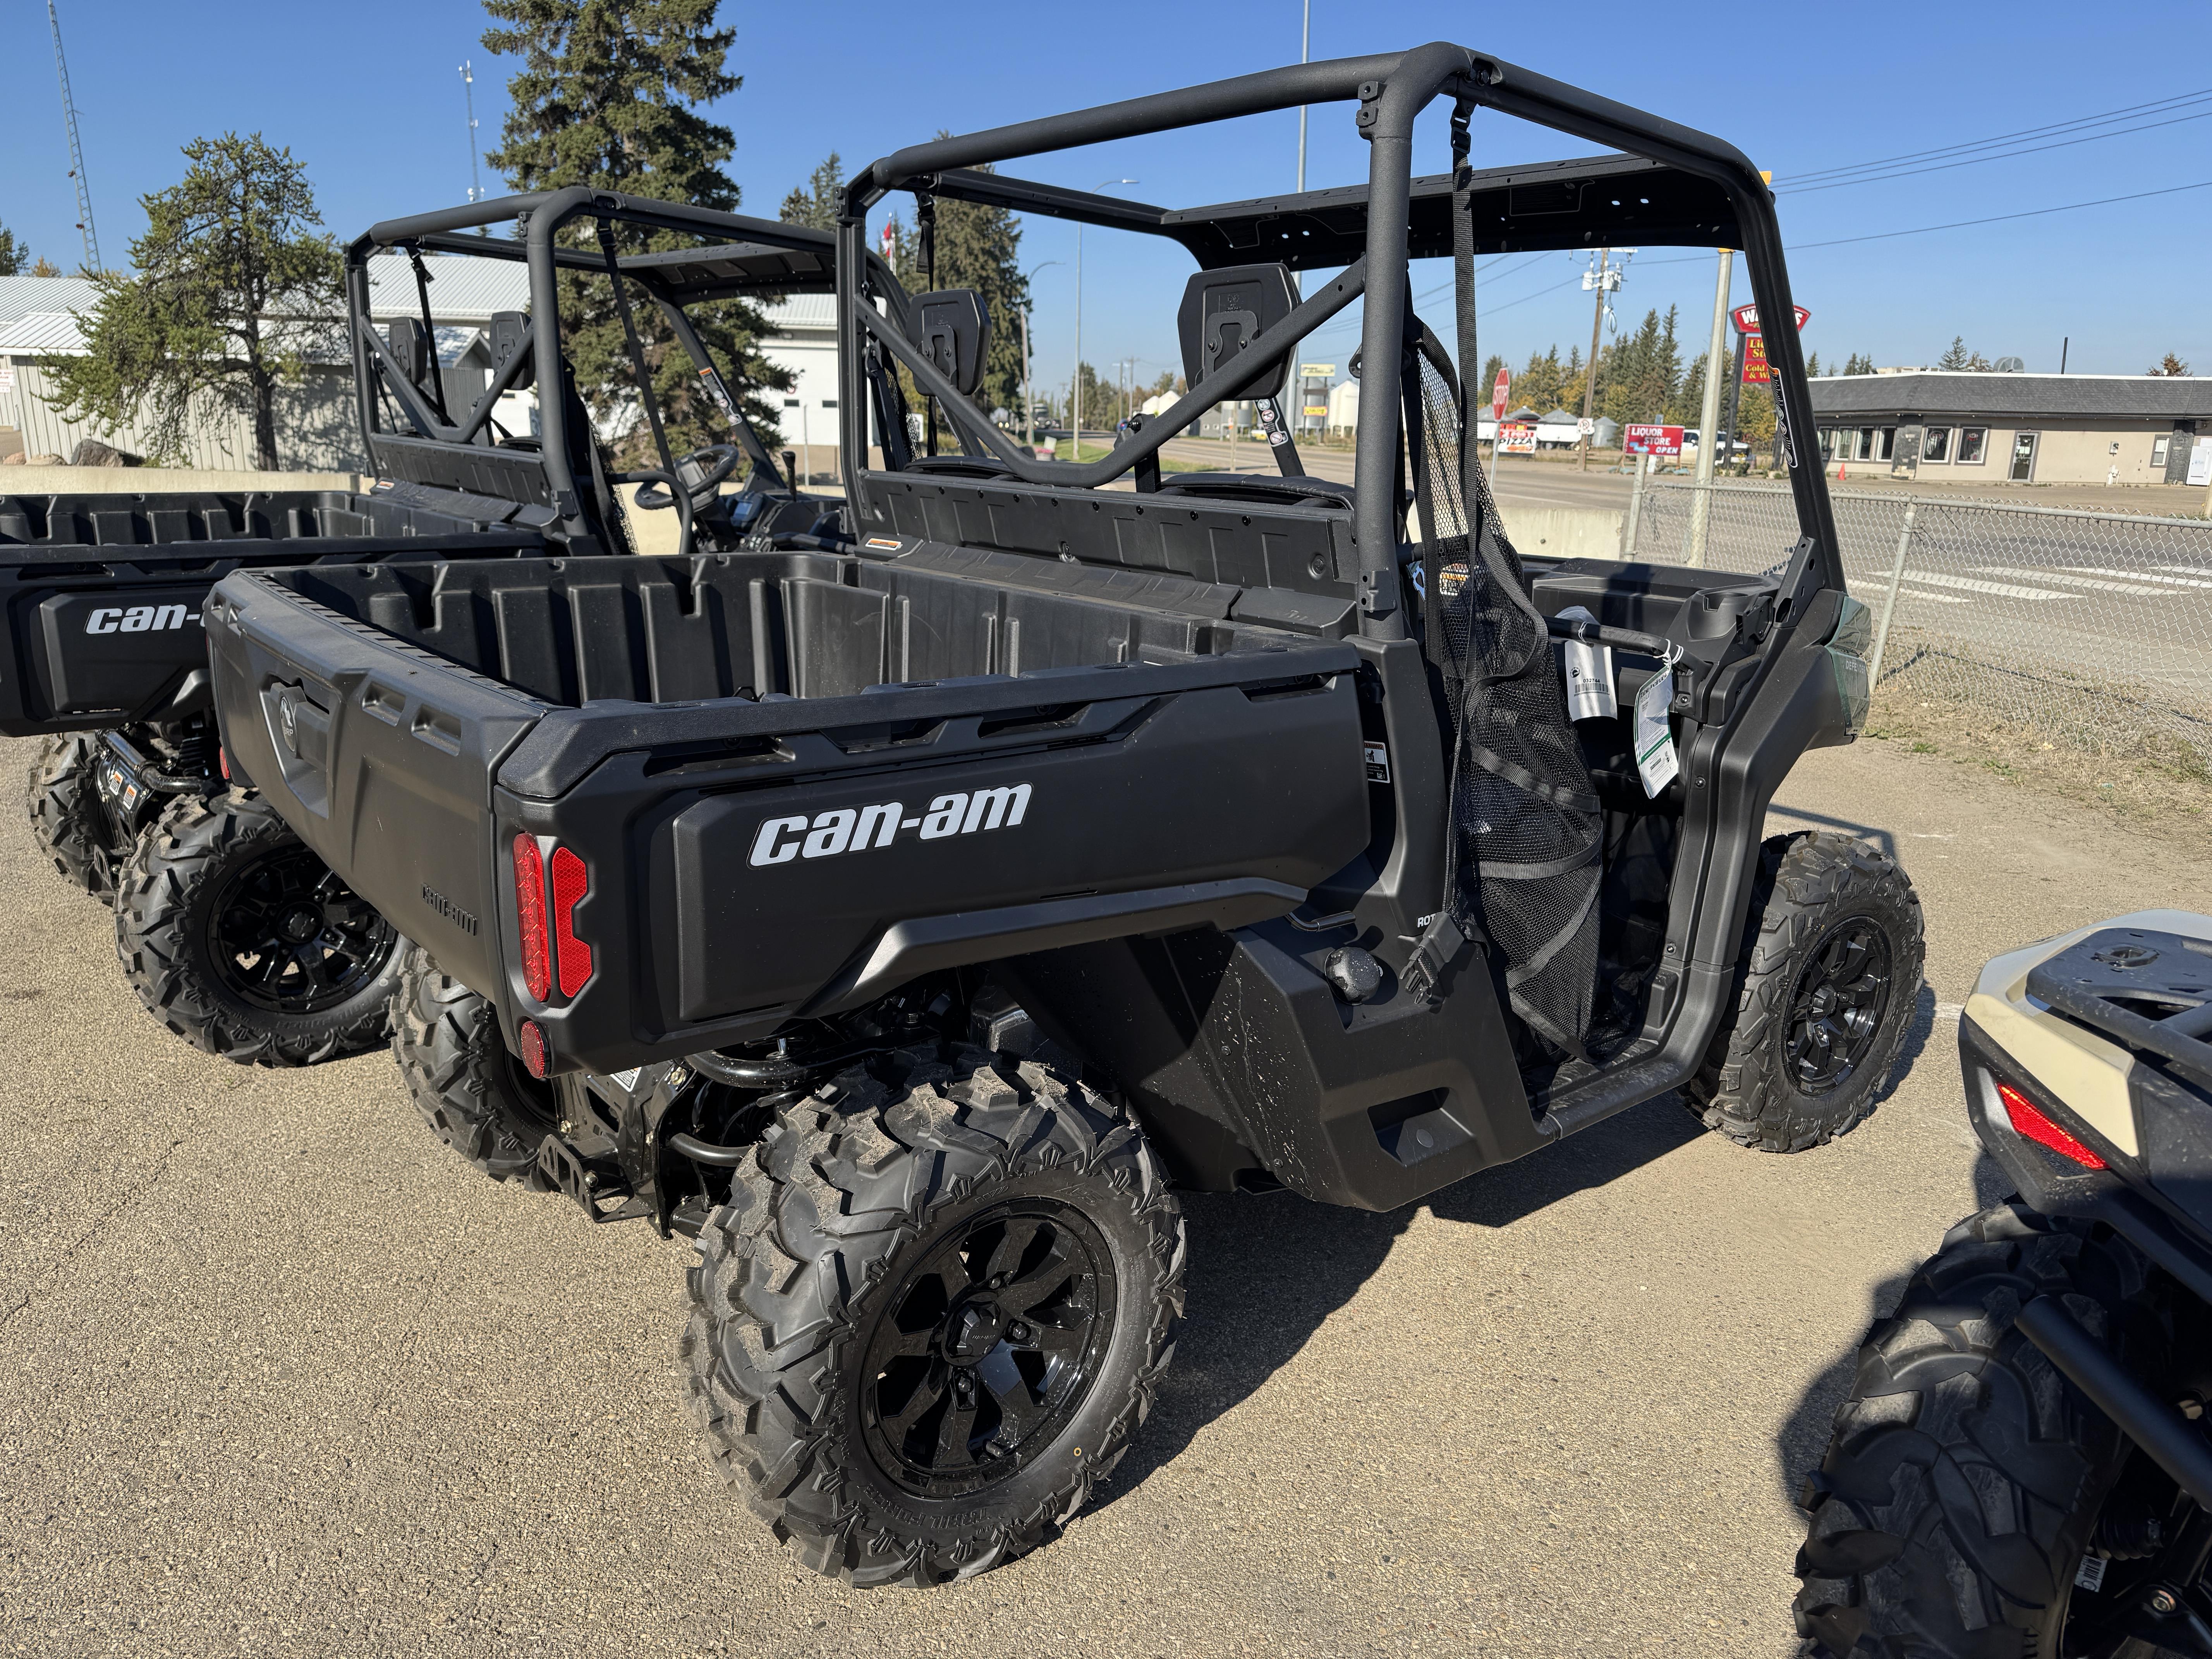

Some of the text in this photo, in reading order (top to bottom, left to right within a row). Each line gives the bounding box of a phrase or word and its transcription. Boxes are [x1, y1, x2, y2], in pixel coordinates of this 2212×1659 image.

[1494, 384, 1508, 405] STOP
[1631, 427, 1663, 437] LIQUOR
[1644, 437, 1671, 446] STORE
[1656, 446, 1678, 454] OPEN
[86, 604, 205, 634] can-
[750, 783, 1032, 866] can-am
[864, 1482, 990, 1529] TRAIL FORCE
